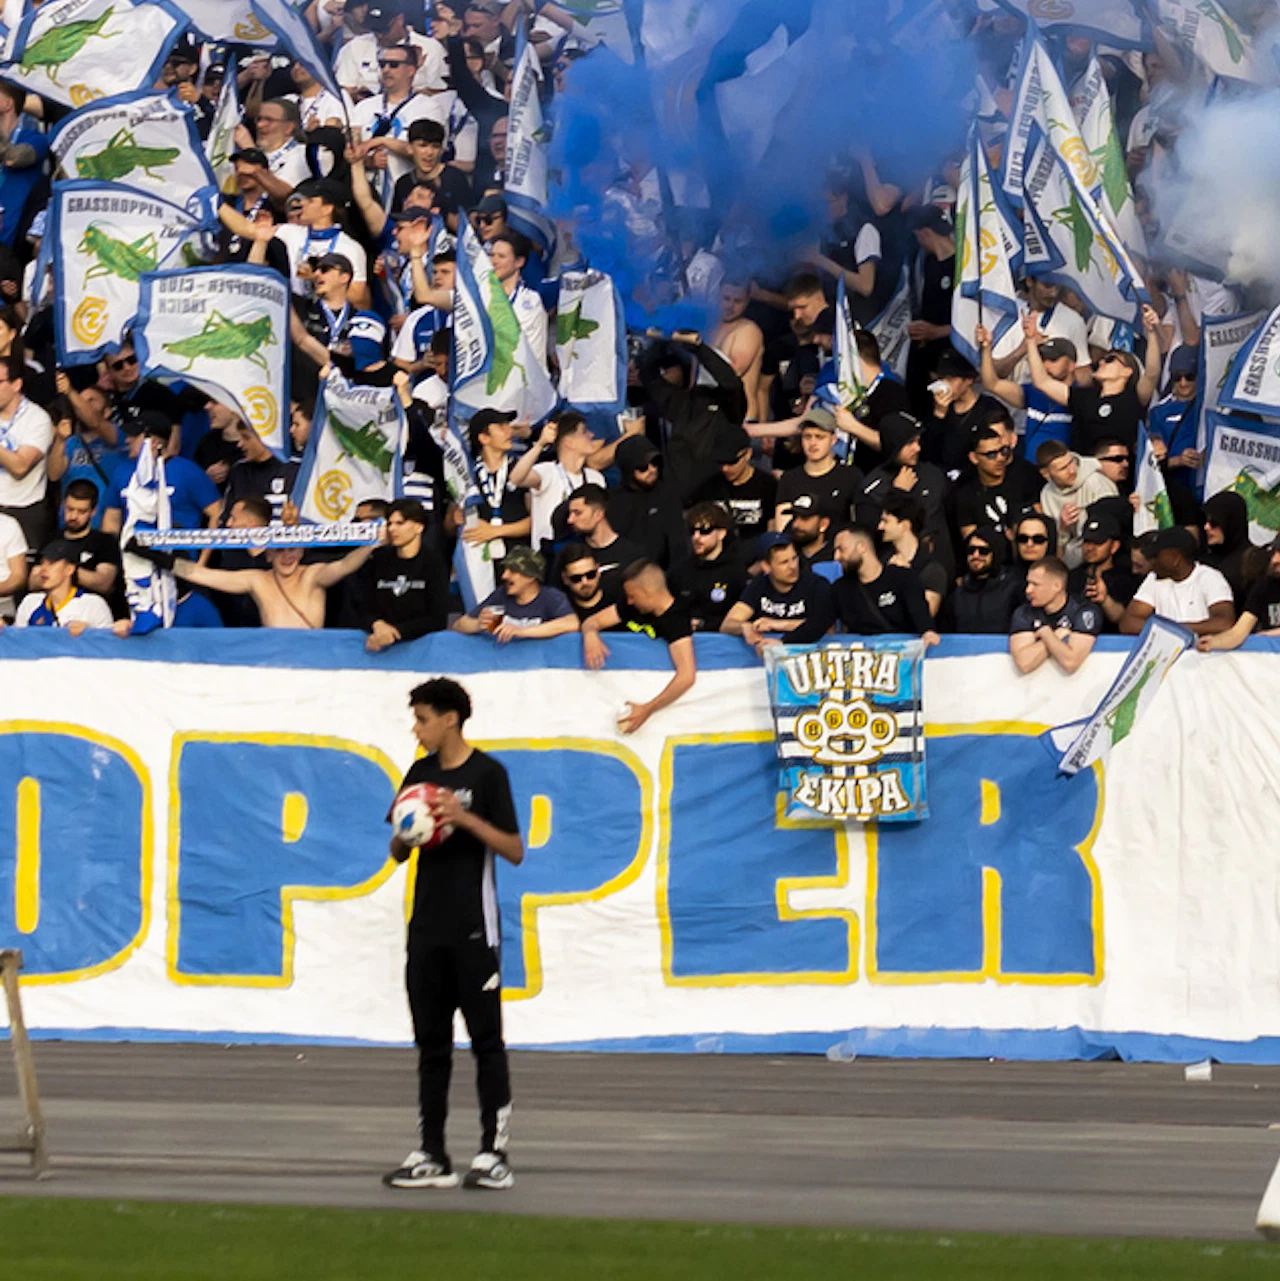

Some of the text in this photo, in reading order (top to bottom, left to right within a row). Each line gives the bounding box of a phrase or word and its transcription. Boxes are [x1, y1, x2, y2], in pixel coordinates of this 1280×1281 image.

[68, 197, 164, 218] GRASSHOPPER
[783, 648, 899, 695] ULTRA
[794, 767, 912, 816] EKIPA
